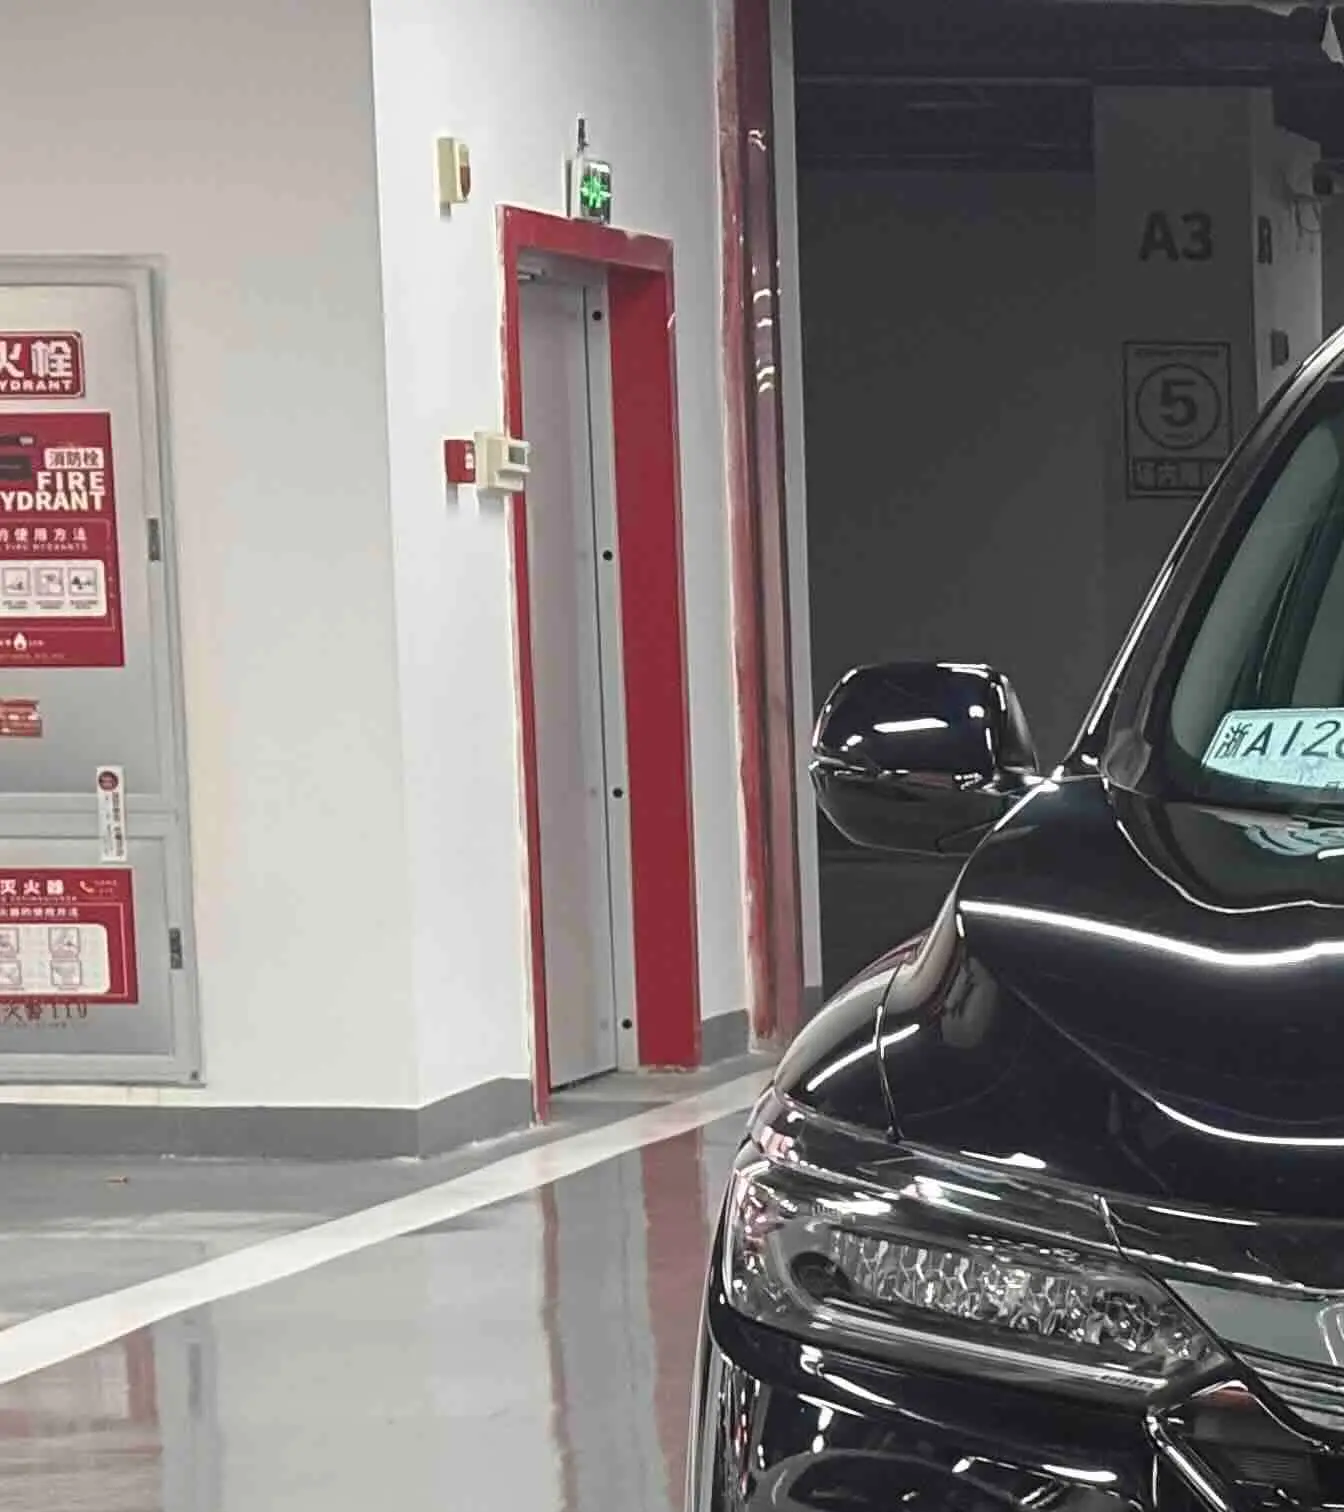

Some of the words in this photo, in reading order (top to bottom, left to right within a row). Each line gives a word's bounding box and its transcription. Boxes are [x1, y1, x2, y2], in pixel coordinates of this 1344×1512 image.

[1139, 210, 1212, 262] A3
[1159, 377, 1198, 427] 5
[36, 471, 105, 492] FIRE
[0, 491, 105, 512] YDRANT
